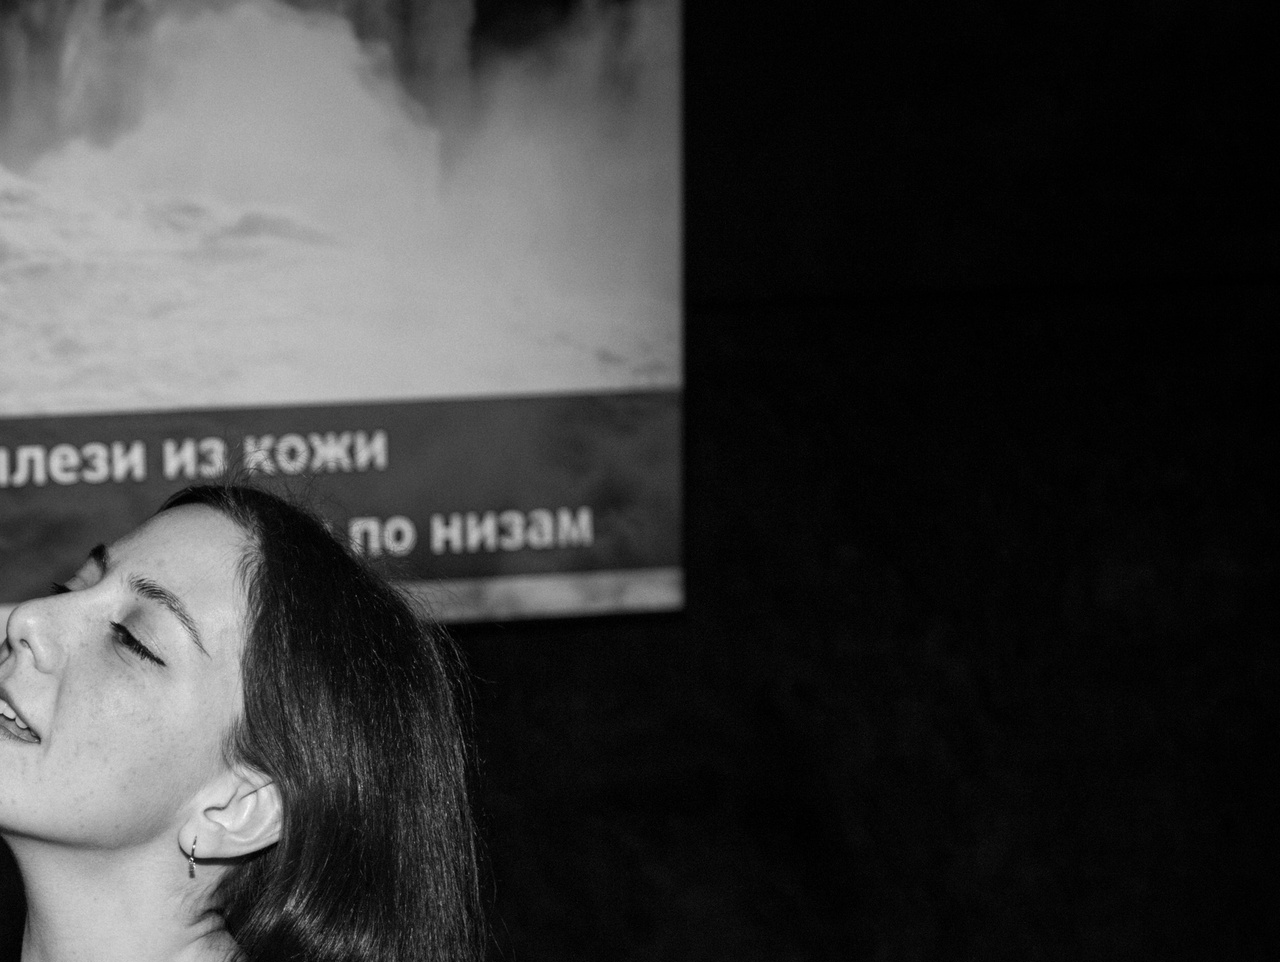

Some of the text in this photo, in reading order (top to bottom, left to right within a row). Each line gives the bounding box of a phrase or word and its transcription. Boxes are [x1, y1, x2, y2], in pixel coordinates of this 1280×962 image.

[163, 437, 227, 480] из
[242, 429, 389, 475] кожи
[349, 507, 594, 557] по низам
